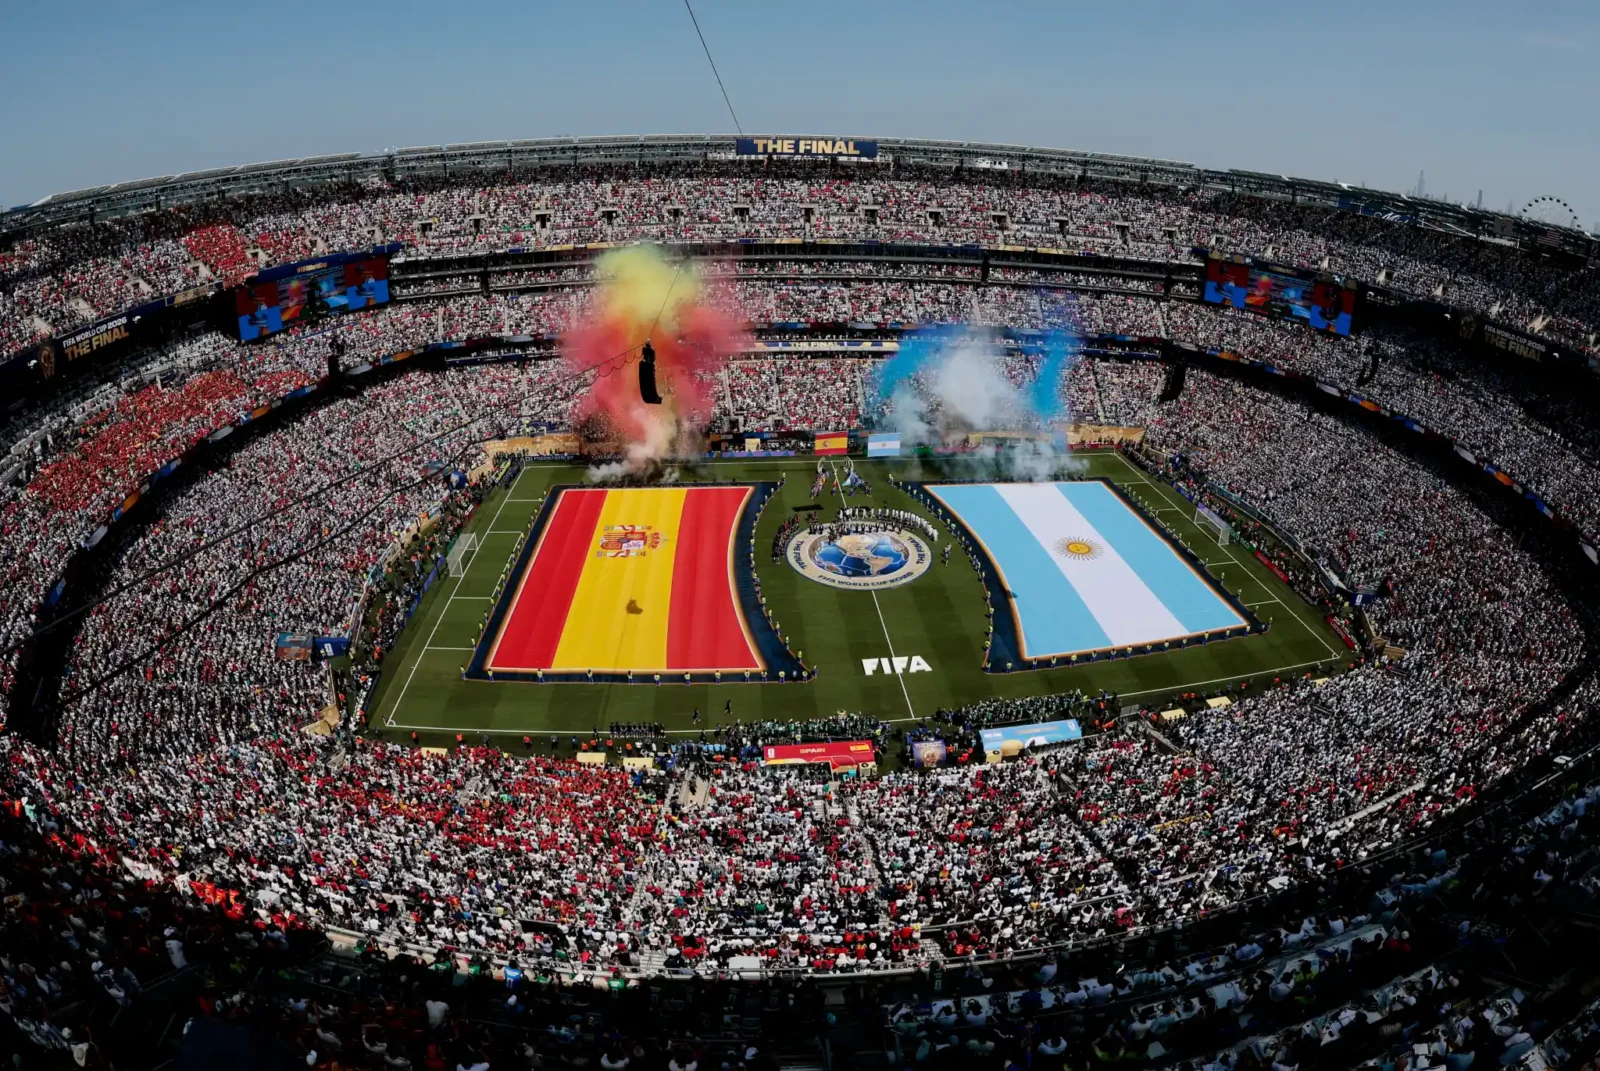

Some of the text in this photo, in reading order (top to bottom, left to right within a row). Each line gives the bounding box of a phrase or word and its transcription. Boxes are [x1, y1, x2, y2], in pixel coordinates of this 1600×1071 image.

[753, 139, 860, 155] THE FINAL
[63, 316, 128, 348] FIFA WORLD CUP 2026
[64, 325, 129, 361] THE FINAL
[1484, 324, 1546, 352] FIFA WORLD CUP 2026
[1484, 331, 1543, 363] THE FINAL
[793, 540, 808, 570] THE FINAL
[909, 537, 926, 565] THE FINAL
[818, 575, 836, 584] FIFA
[887, 572, 914, 583] 2026
[861, 655, 932, 676] FIFA
